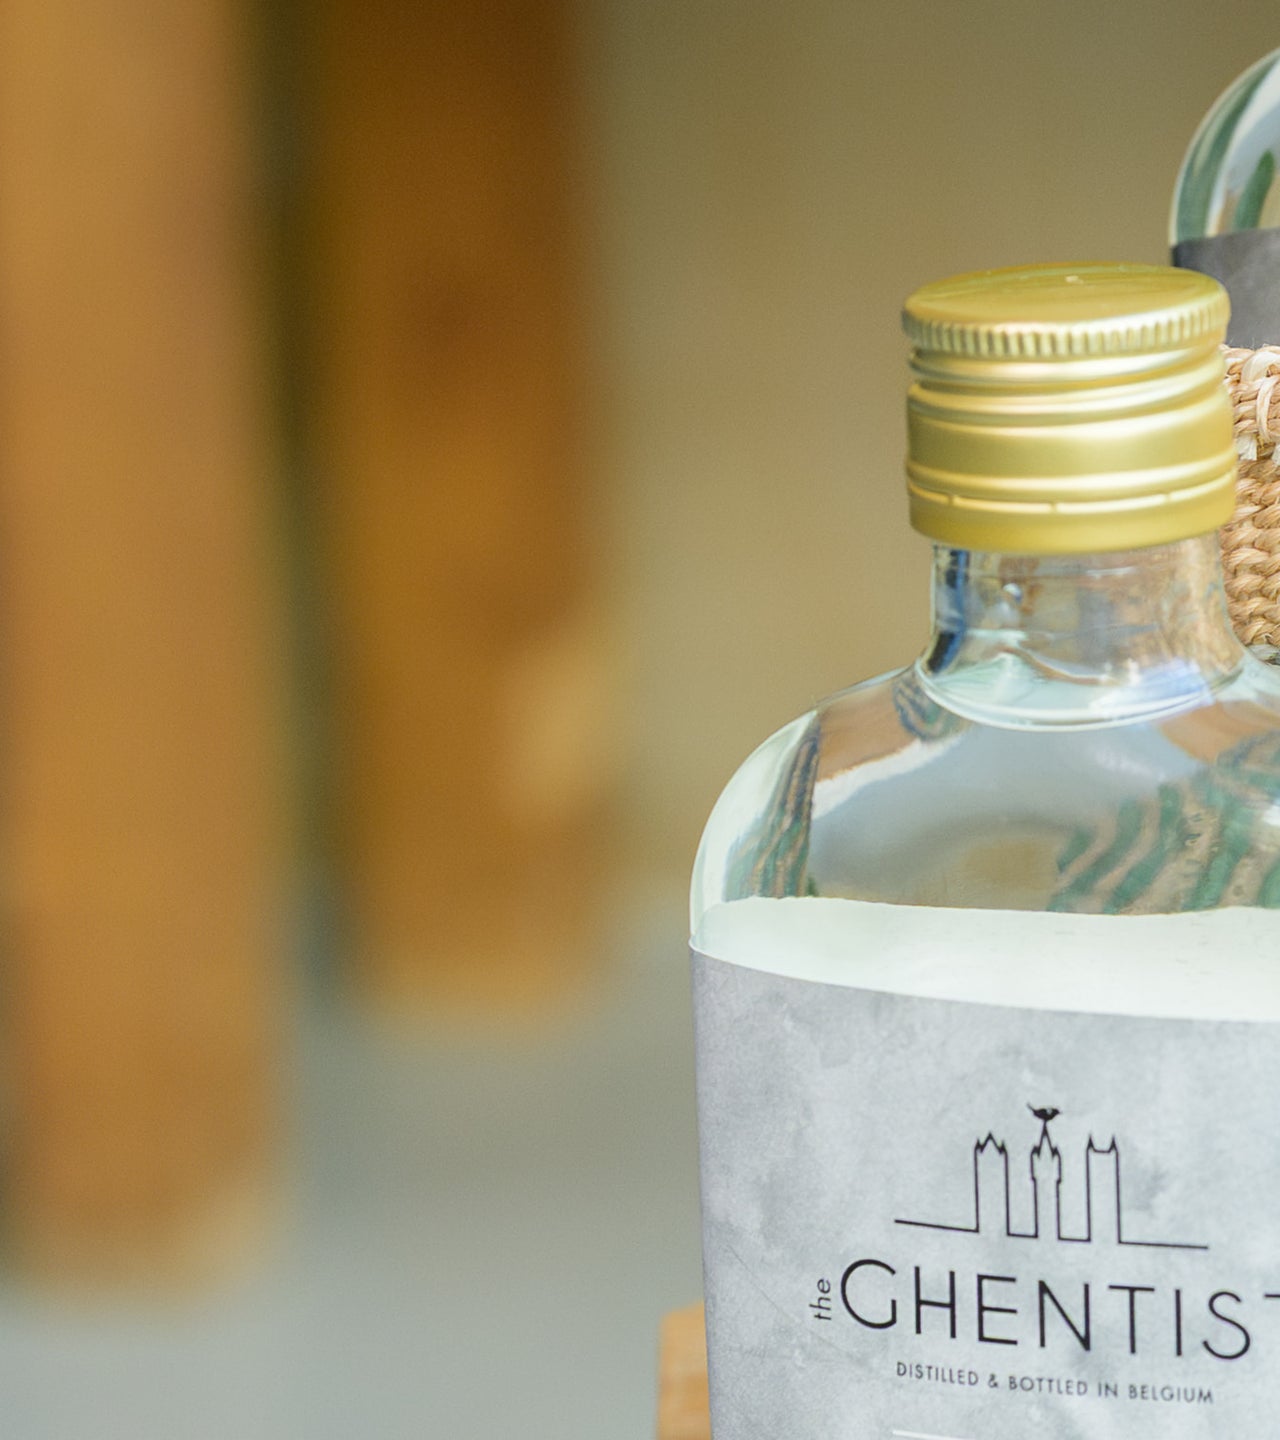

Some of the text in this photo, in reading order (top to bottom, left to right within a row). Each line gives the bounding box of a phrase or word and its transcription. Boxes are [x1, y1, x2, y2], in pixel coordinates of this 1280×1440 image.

[809, 1277, 832, 1321] the
[896, 1361, 1214, 1404] DISTILLED & BOTTLED IN BELGIUM
